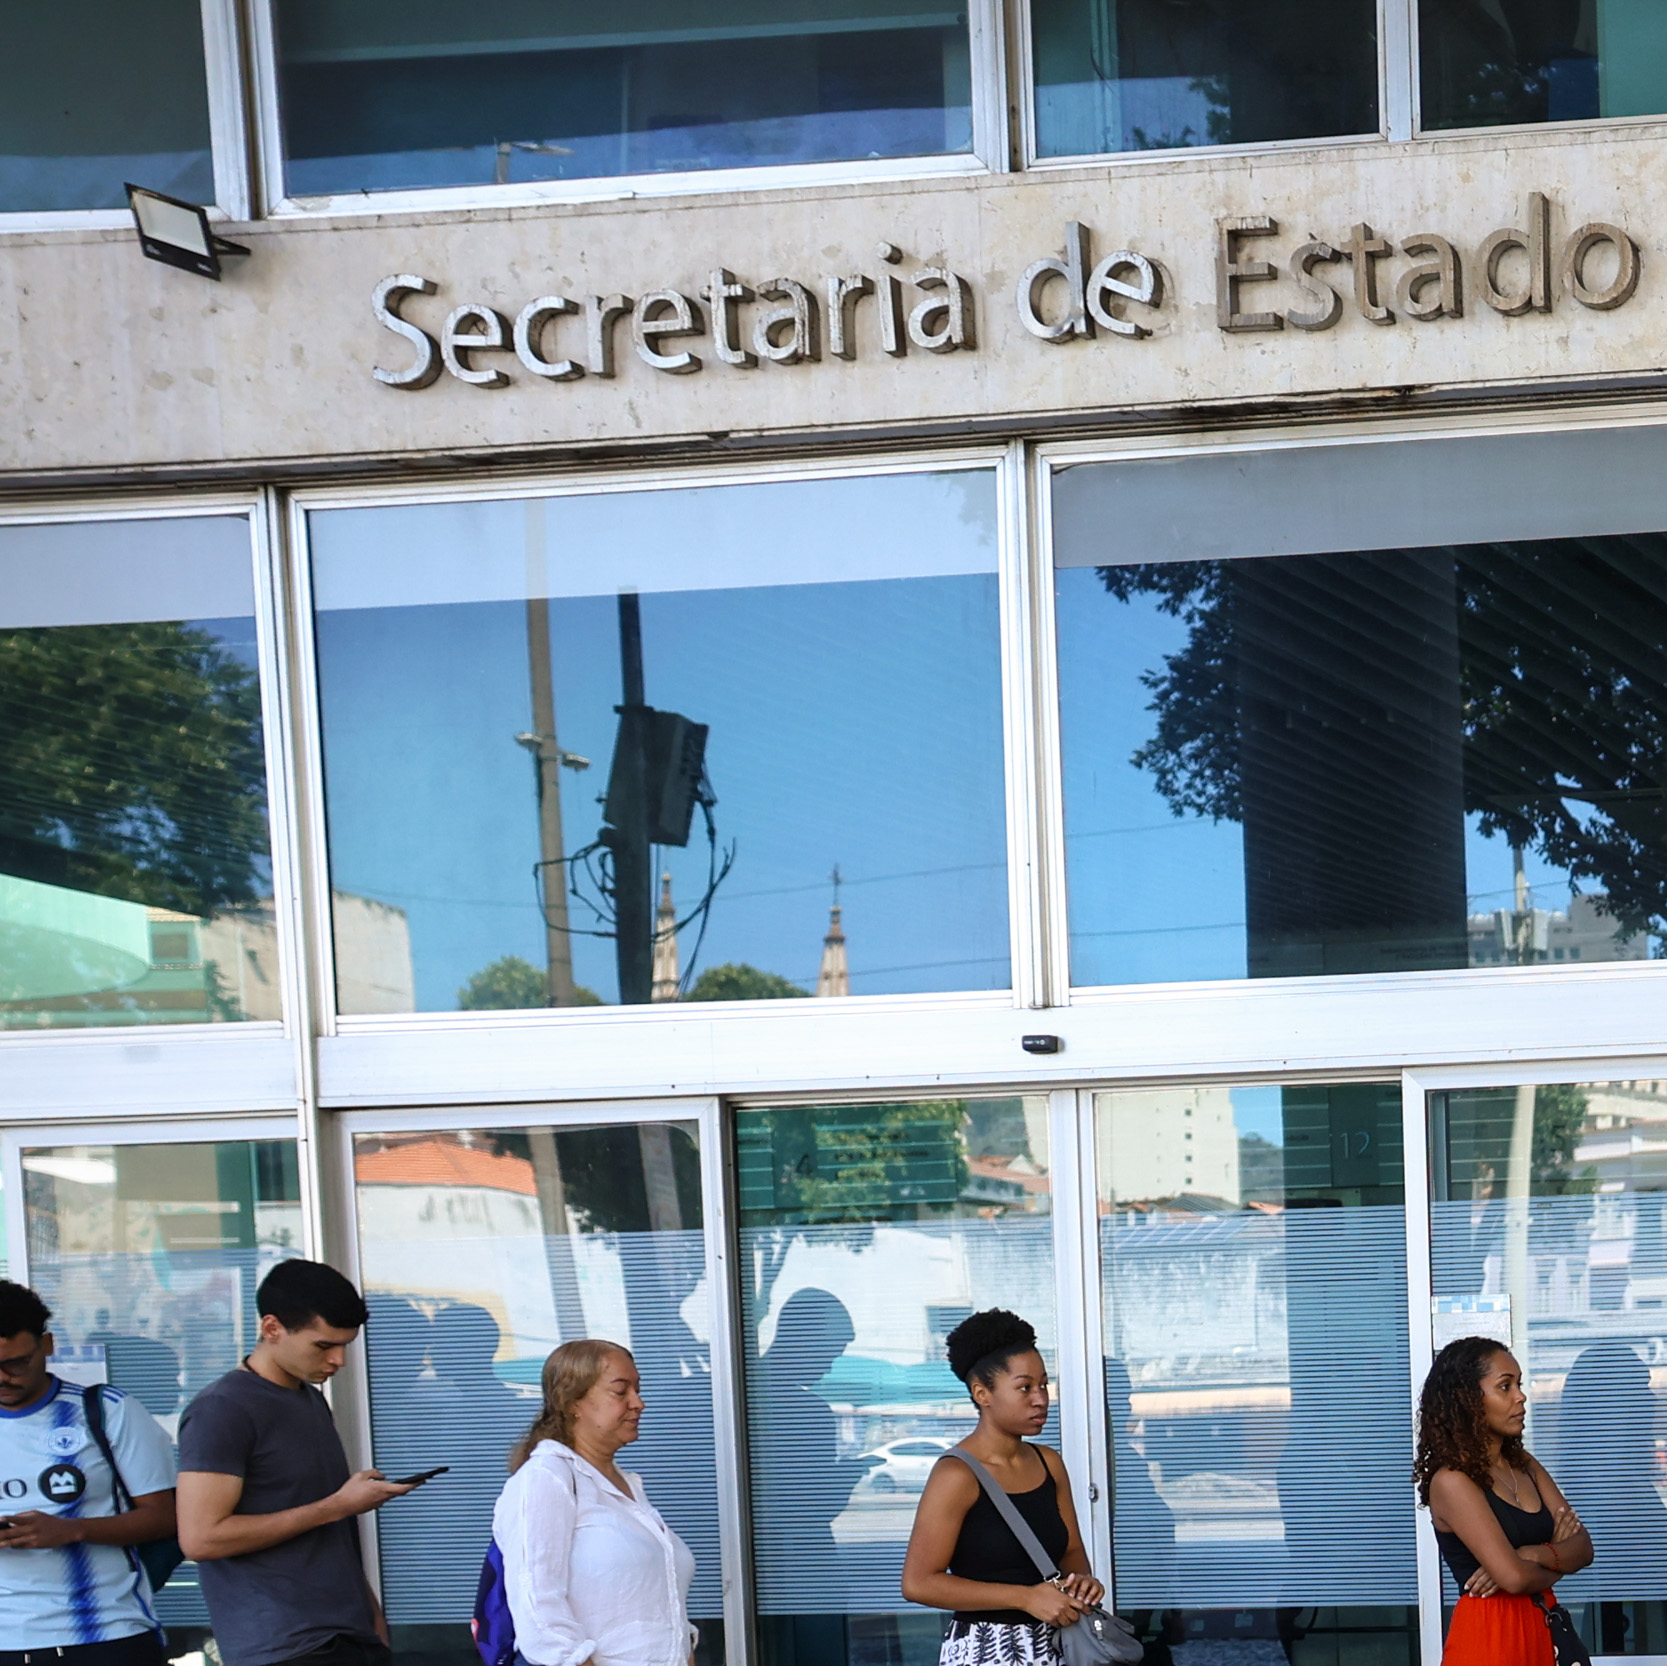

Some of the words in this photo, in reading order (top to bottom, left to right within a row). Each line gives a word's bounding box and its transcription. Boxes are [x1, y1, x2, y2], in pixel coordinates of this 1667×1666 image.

[370, 241, 977, 390] Secretaria
[1015, 220, 1164, 343] de
[1214, 190, 1641, 333] Estado
[1340, 1131, 1373, 1159] 12
[0, 1478, 28, 1499] O
